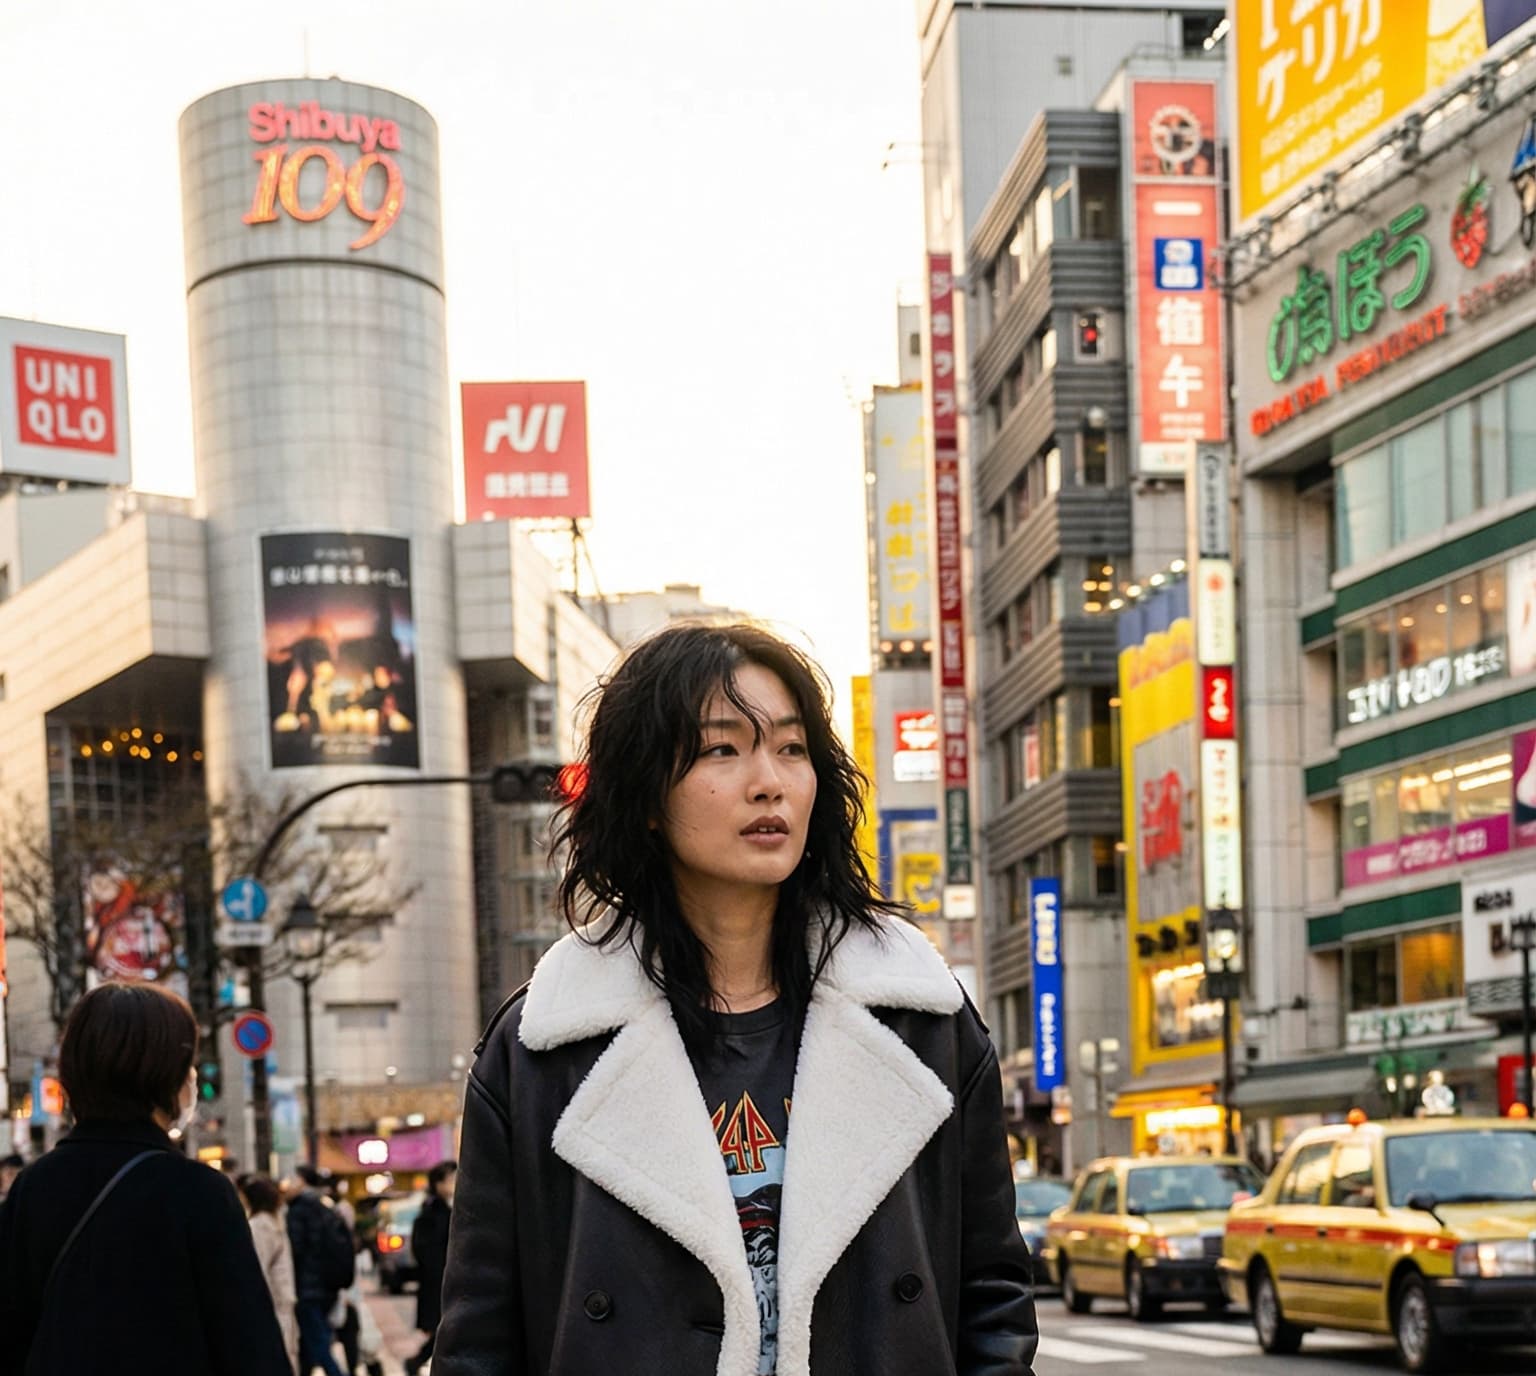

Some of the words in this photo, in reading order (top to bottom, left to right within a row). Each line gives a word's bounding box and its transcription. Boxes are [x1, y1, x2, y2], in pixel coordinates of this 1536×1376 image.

[249, 101, 401, 153] Shibuya
[242, 144, 405, 249] 109
[25, 357, 96, 401] UNI
[28, 398, 106, 442] QLO
